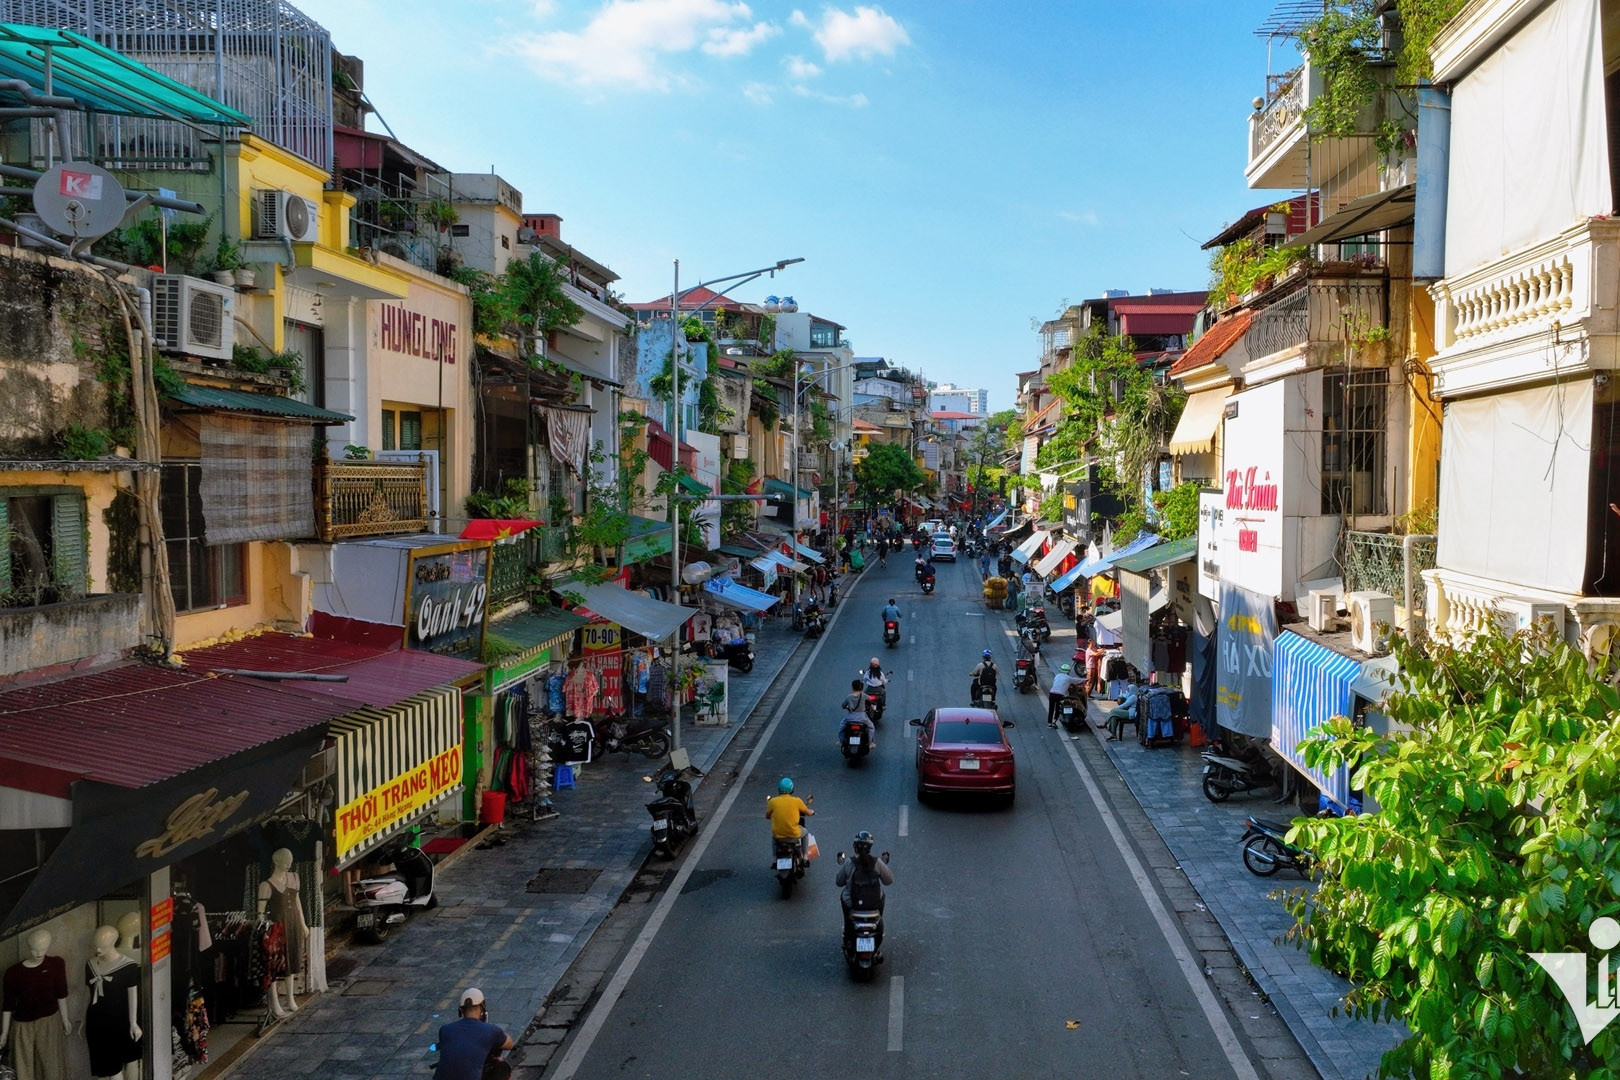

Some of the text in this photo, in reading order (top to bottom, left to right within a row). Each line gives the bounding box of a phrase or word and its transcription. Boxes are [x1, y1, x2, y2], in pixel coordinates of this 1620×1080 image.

[417, 583, 487, 641] Oanh 42
[584, 628, 620, 645] 70-90%
[1223, 633, 1240, 674] HÀ
[339, 748, 460, 836] THỜI TRANG MEO
